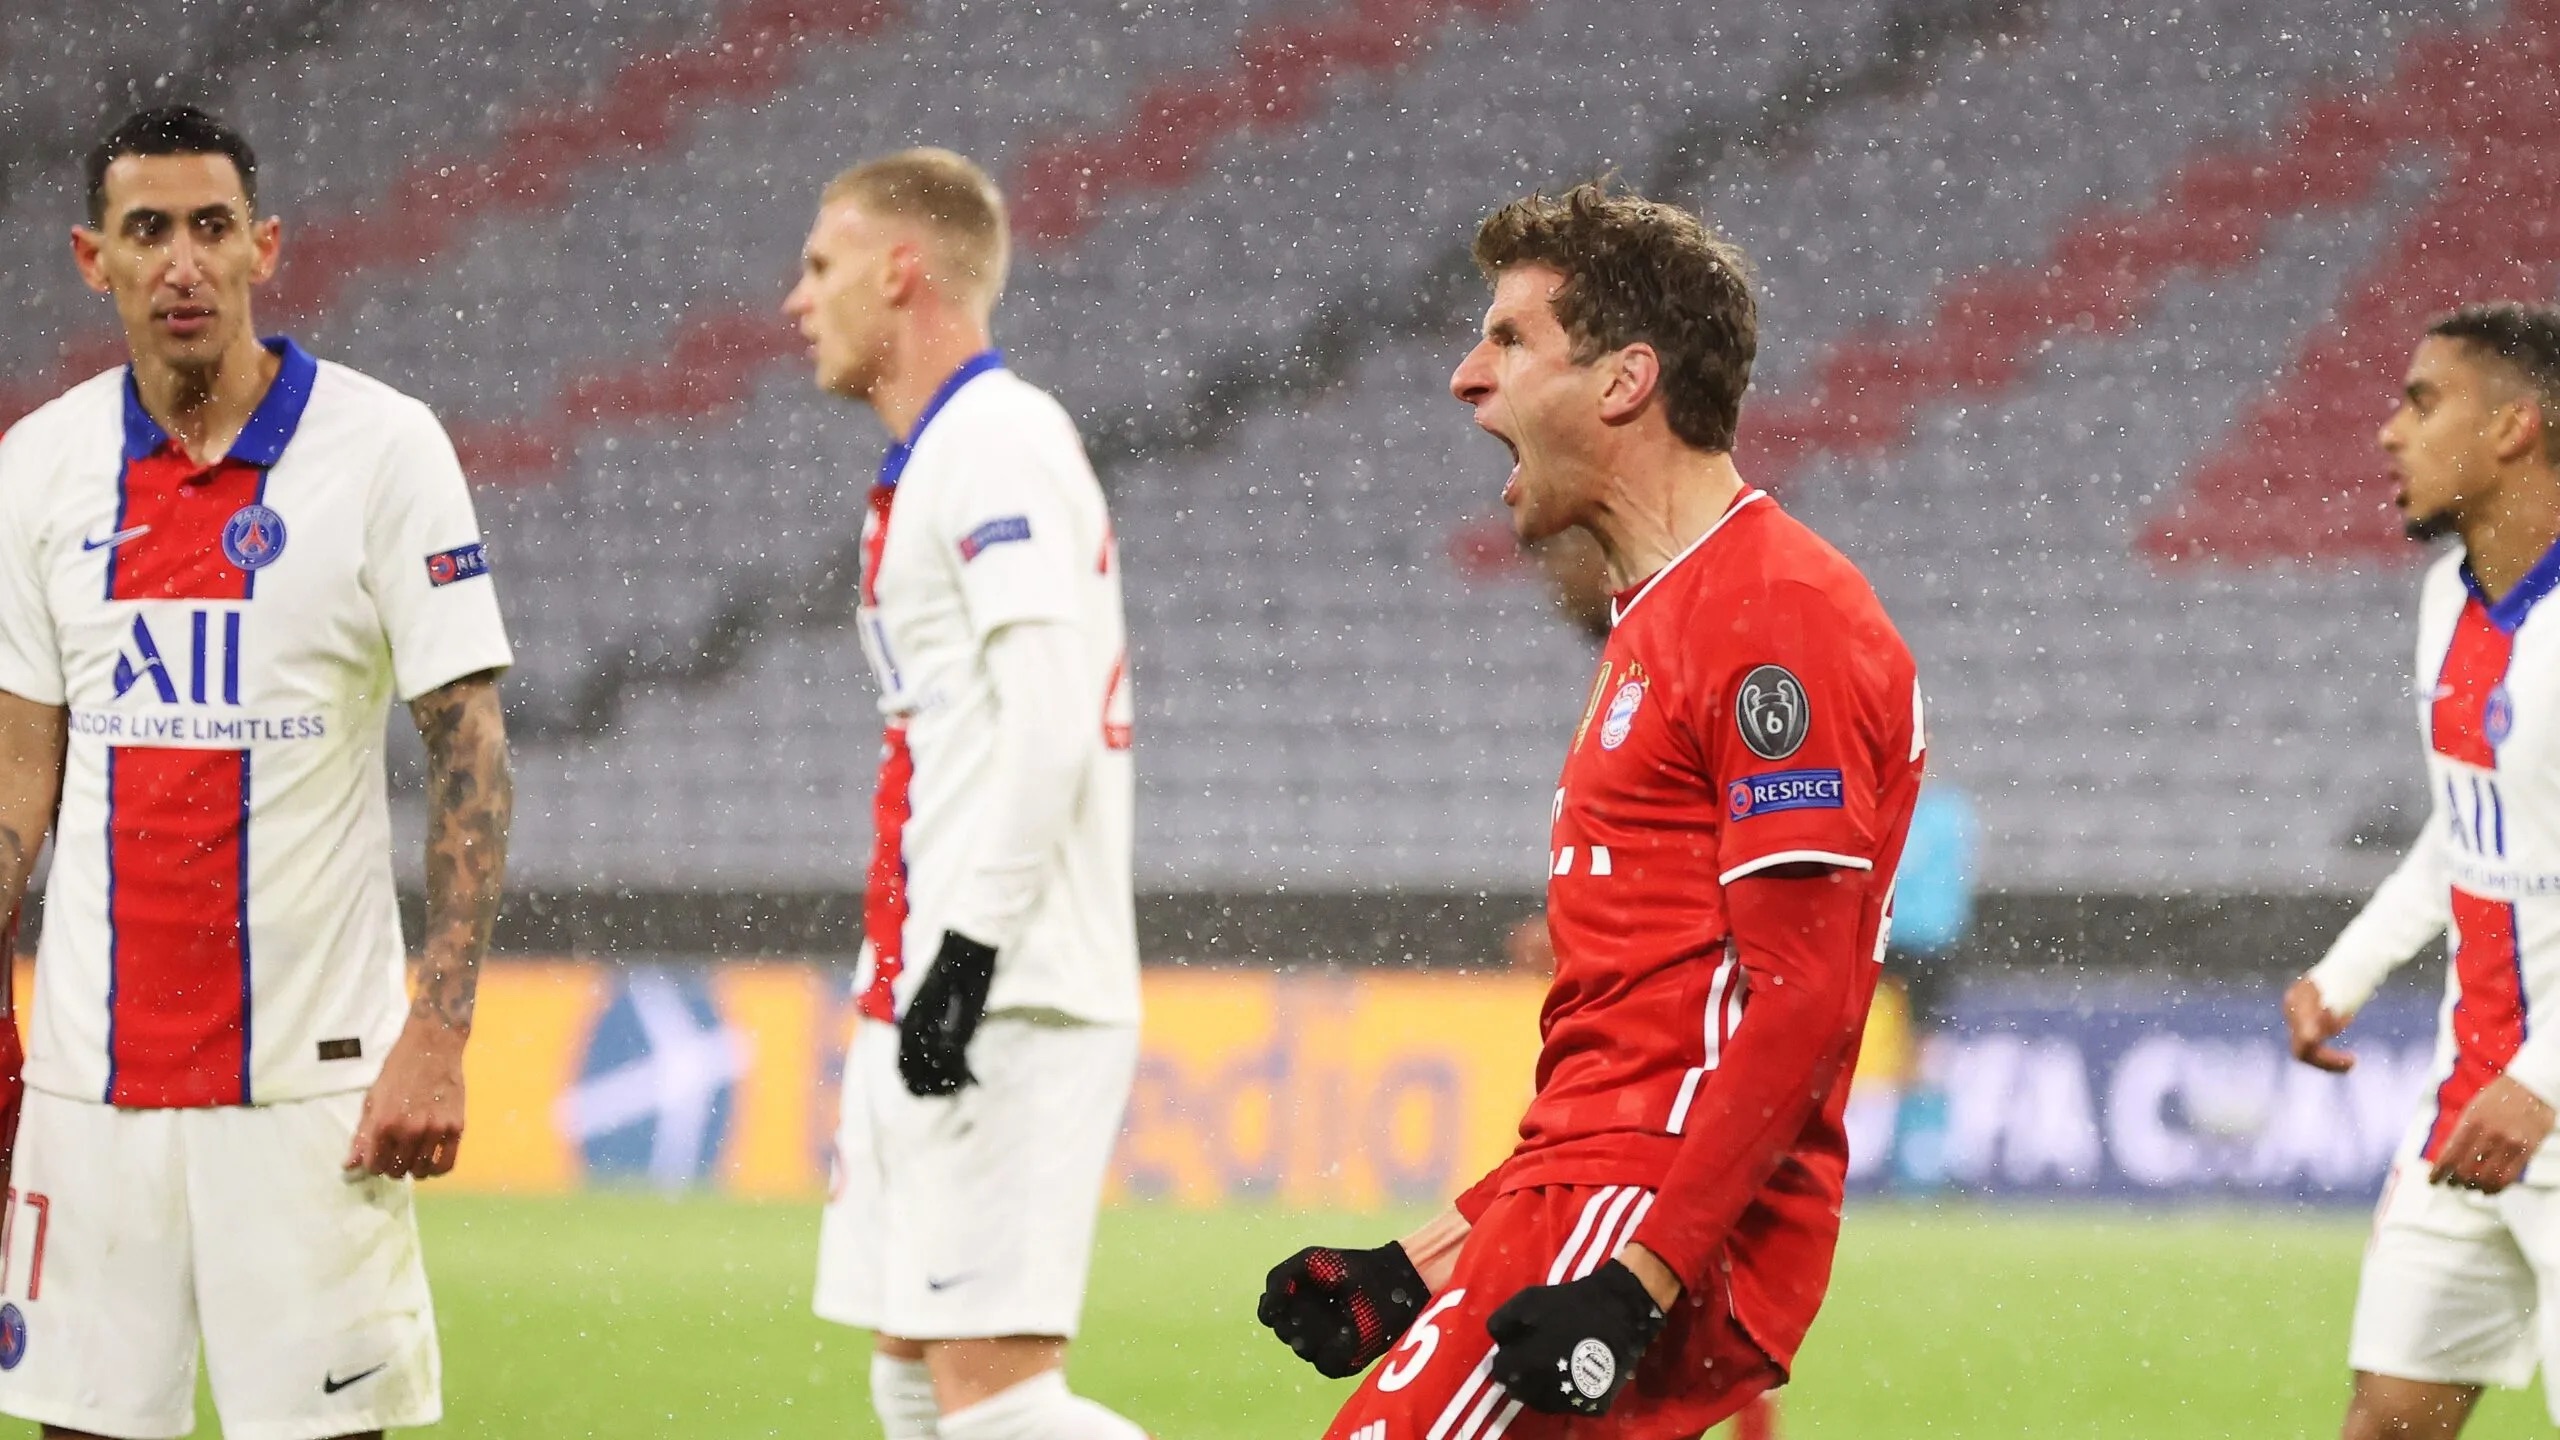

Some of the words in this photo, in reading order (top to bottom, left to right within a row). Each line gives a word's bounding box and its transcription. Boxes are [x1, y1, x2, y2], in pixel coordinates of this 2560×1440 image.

[131, 716, 185, 739] LIVE
[193, 716, 326, 741] LIMITLESS
[1766, 711, 1784, 734] 6
[1754, 780, 1841, 804] RESPECT
[1376, 1287, 1467, 1392] 5
